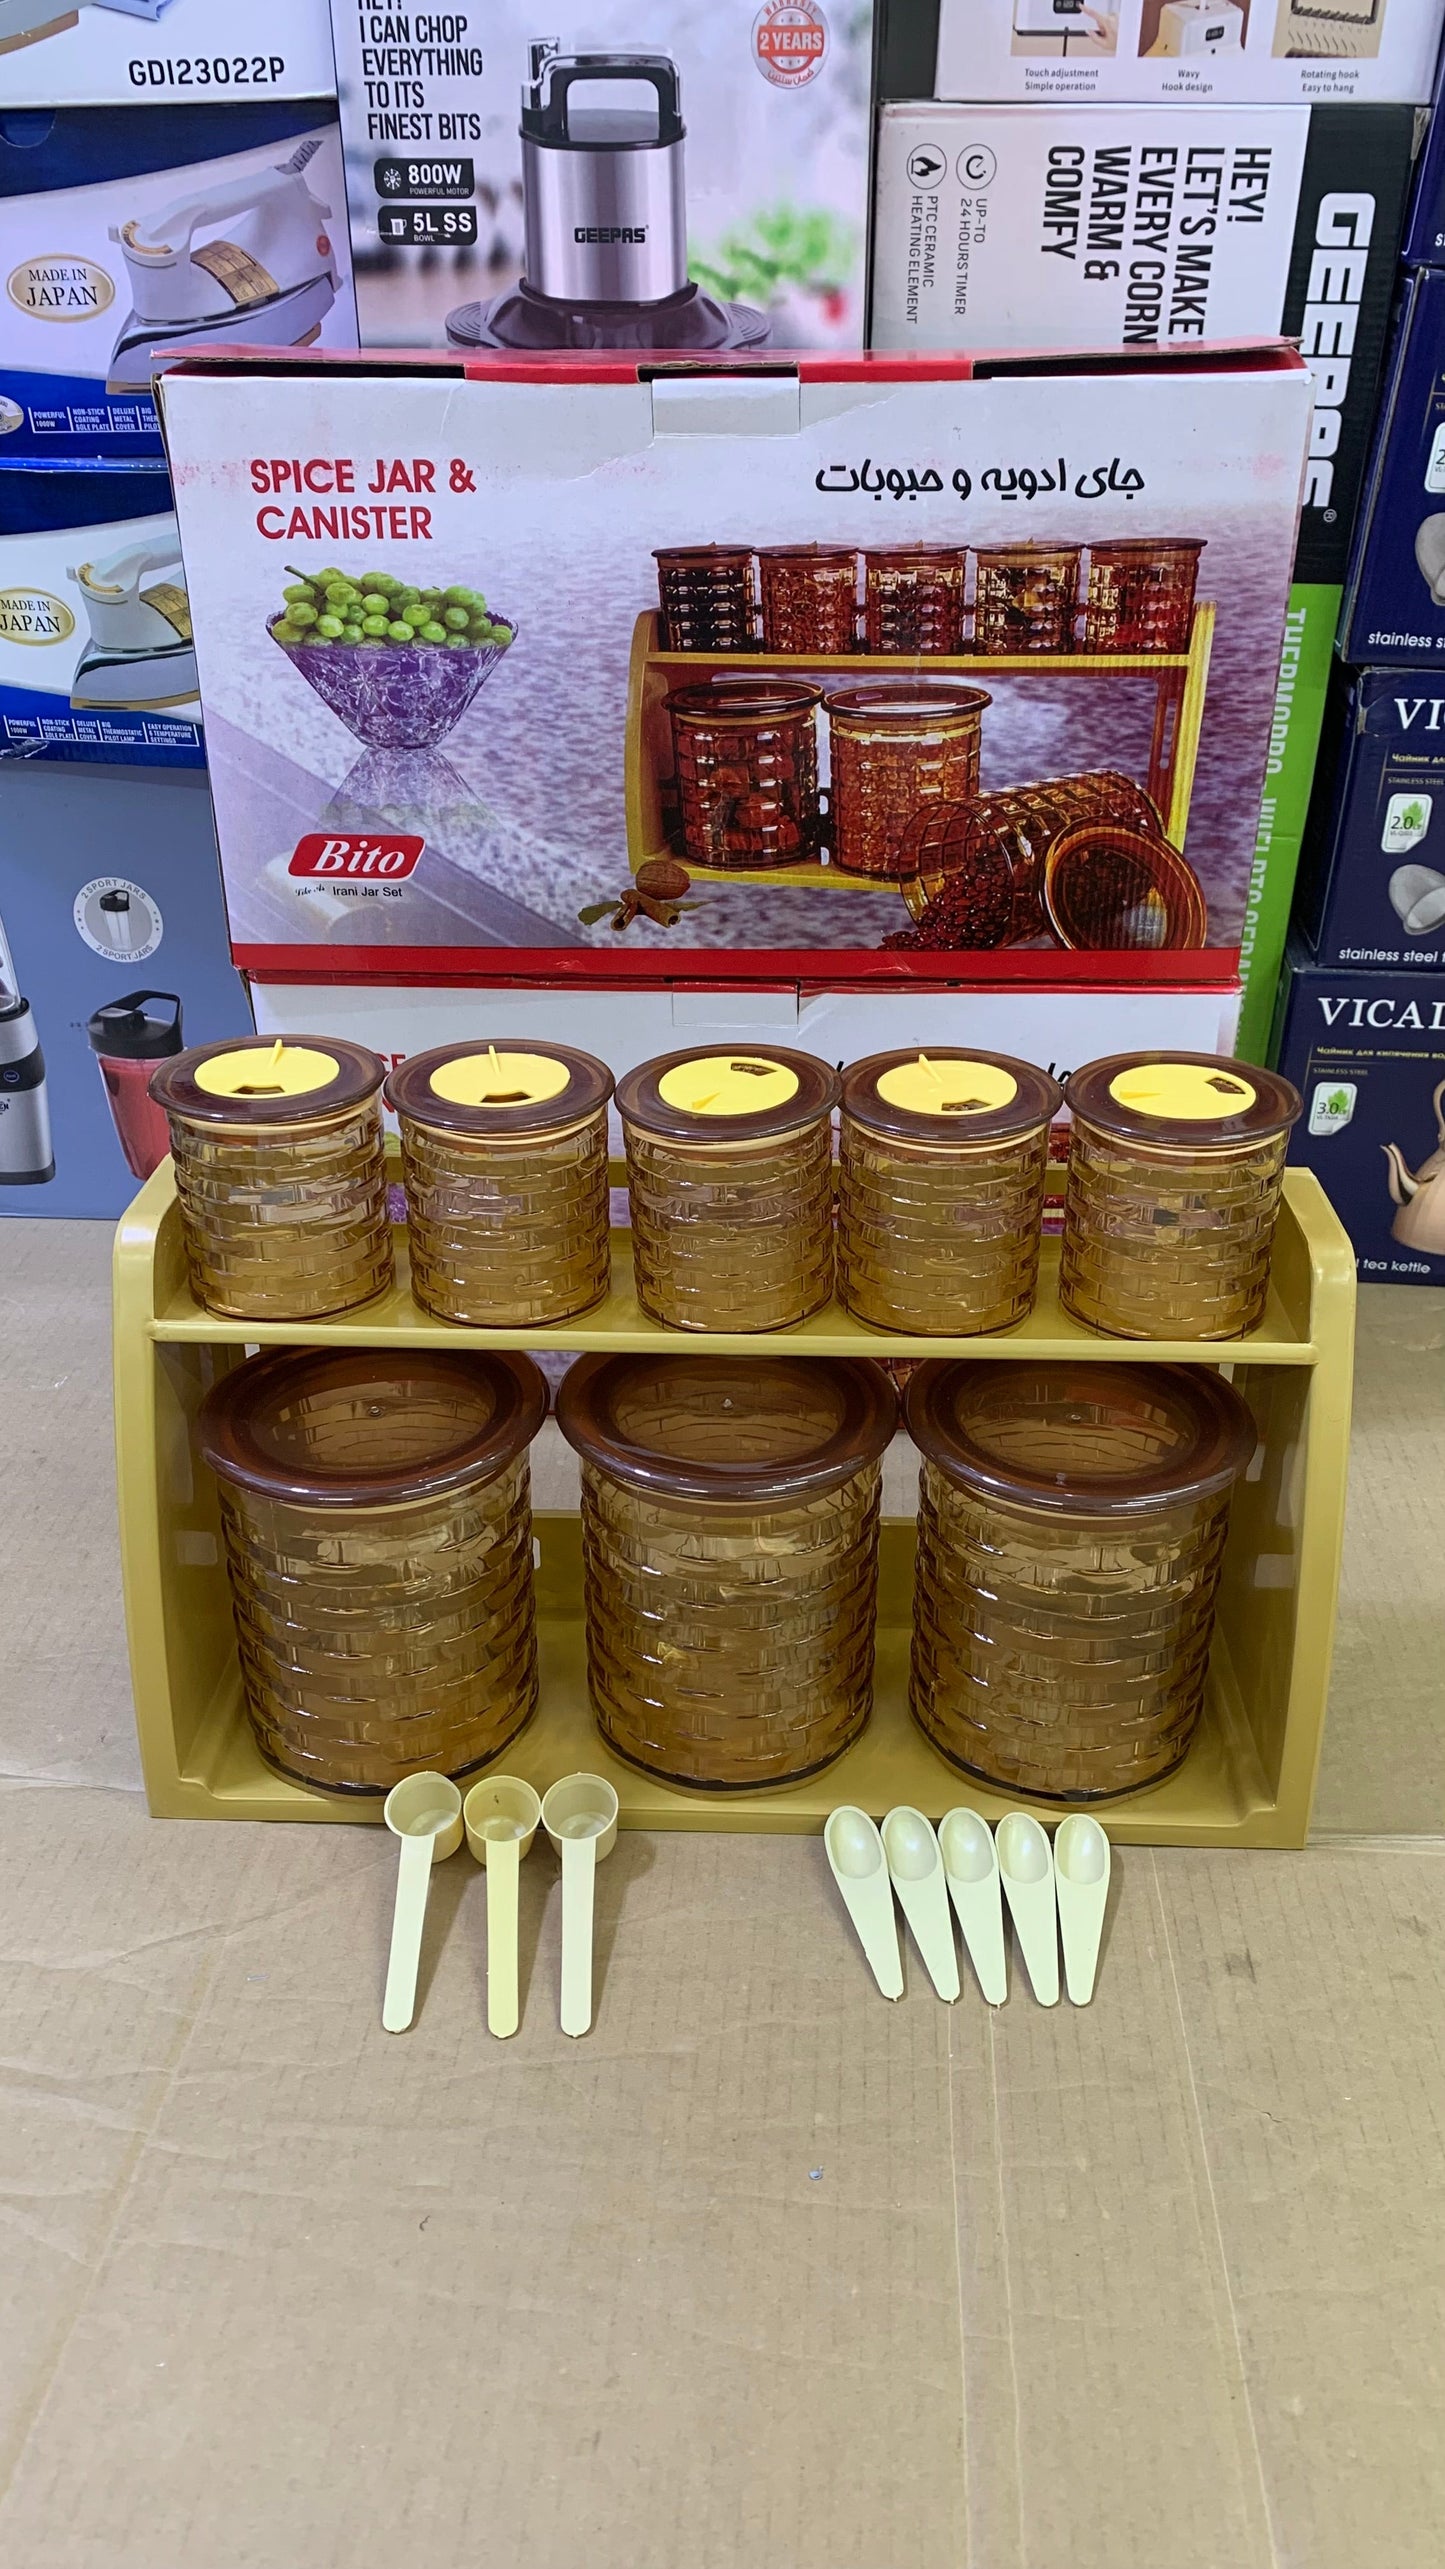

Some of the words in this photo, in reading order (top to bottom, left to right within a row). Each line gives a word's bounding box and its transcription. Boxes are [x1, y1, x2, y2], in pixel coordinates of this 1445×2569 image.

[359, 15, 366, 43] I
[370, 15, 410, 43] CAN
[415, 15, 468, 43] CHOP
[760, 32, 770, 50] 2
[772, 32, 823, 50] YEARS
[128, 56, 286, 86] GDI23022P
[362, 48, 483, 76] EVERYTHING
[1025, 68, 1050, 78] Touch
[1051, 68, 1099, 79] adjustment
[1178, 70, 1200, 80] Wavy
[1301, 70, 1337, 80] Rotating
[1338, 70, 1360, 79] hook
[364, 81, 390, 109] TO
[394, 81, 425, 109] ITS
[1025, 82, 1053, 92] Simple
[1055, 82, 1096, 92] operation
[1161, 83, 1183, 91] Hook
[1185, 83, 1213, 93] design
[1302, 83, 1321, 93] Easy
[1323, 83, 1332, 92] to
[1333, 83, 1354, 93] hang
[367, 113, 433, 140] FINEST
[439, 113, 481, 140] BITS
[408, 164, 462, 185] 800W
[1226, 147, 1273, 223] HEY!
[409, 187, 445, 195] POWERFUL
[446, 187, 469, 195] MOTOR
[1086, 145, 1132, 251] WARM
[1133, 146, 1179, 254] EVERY
[926, 196, 938, 222] PTC
[960, 197, 972, 217] 24
[1041, 145, 1086, 260] COMFY
[413, 212, 439, 232] 5L
[443, 212, 472, 232] SS
[909, 195, 922, 257] HEATING
[973, 198, 988, 243] UP-TO
[413, 234, 436, 242] BOWL
[574, 228, 646, 243] GEEPAS
[957, 220, 971, 270] HOURS
[923, 225, 937, 288] CERAMIC
[29, 267, 70, 282] MADE
[73, 268, 87, 281] IN
[1084, 259, 1119, 281] &
[26, 285, 99, 307] JAPAN
[906, 260, 920, 324] ELEMENT
[954, 272, 968, 315] TIMER
[1167, 244, 1213, 336] MAKE
[33, 411, 66, 419] POWERFUL
[113, 407, 136, 415] DELUXE
[250, 458, 356, 494] SPICE
[367, 458, 436, 494] JAR
[448, 458, 478, 494] &
[951, 467, 972, 500] و
[256, 505, 433, 540] CANISTER
[1, 600, 36, 611] MADE
[37, 600, 51, 611] IN
[0, 614, 61, 632] JAPAN
[1368, 631, 1432, 648] stainless
[8, 719, 36, 727] POWERFUL
[1393, 697, 1445, 731] VI
[103, 728, 143, 736] THERMOSTATIC
[1388, 776, 1424, 785] STAINLESS
[309, 840, 405, 873] Bito
[81, 891, 89, 899] 2
[86, 879, 118, 894] SPORT
[120, 881, 147, 900] JARS
[332, 886, 358, 896] Irani
[361, 886, 379, 896] Jar
[383, 886, 403, 897] Set
[96, 944, 103, 952] 2
[102, 949, 132, 961] SPORT
[134, 944, 153, 960] JARS
[1338, 948, 1399, 961] stainless
[1403, 950, 1438, 963] steel
[1363, 1259, 1388, 1270] tea
[1391, 1261, 1431, 1274] kettle
